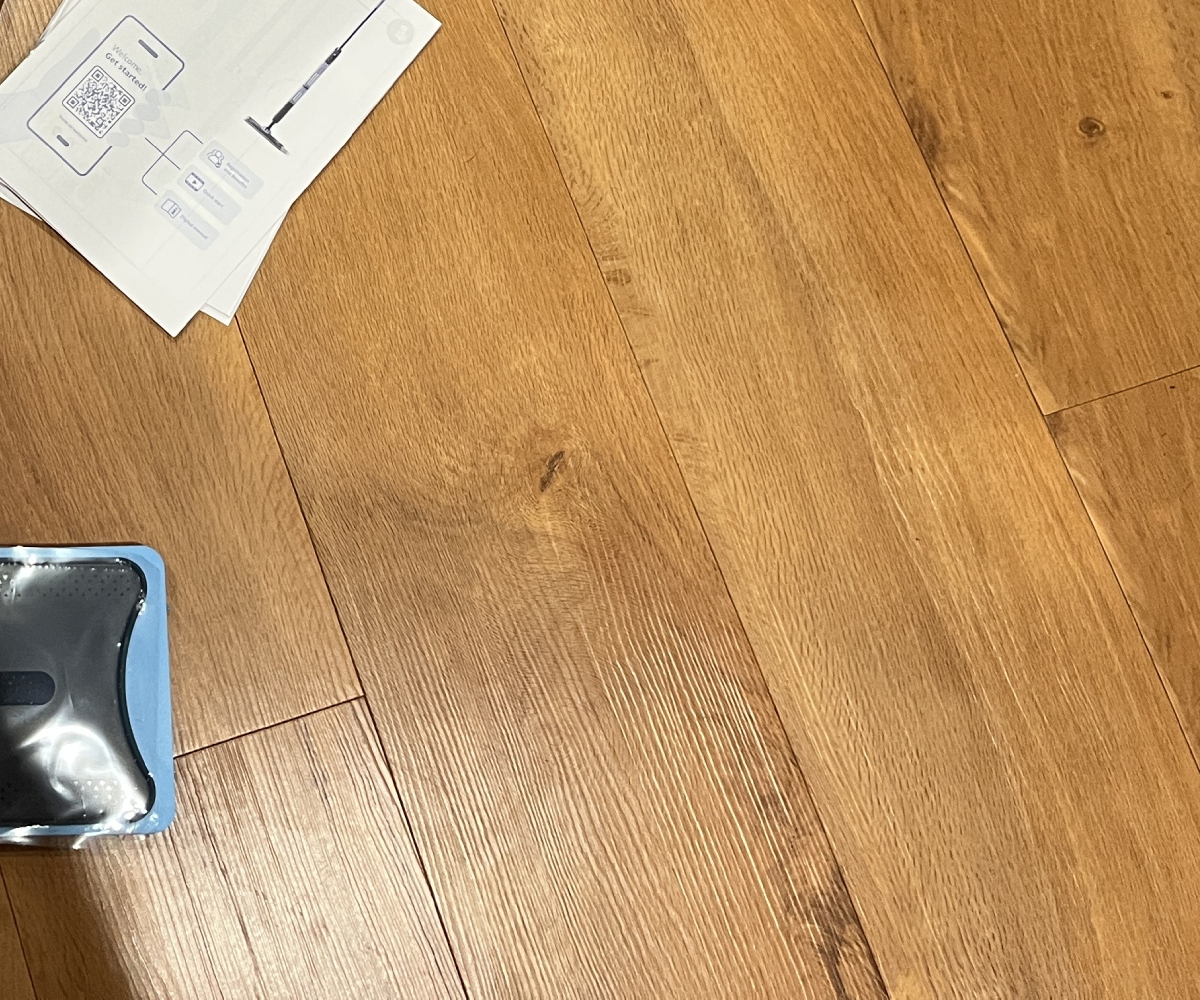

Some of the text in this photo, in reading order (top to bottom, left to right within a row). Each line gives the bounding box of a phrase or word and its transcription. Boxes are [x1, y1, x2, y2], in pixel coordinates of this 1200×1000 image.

[105, 52, 148, 92] Get started!
[112, 44, 142, 75] Welcome,
